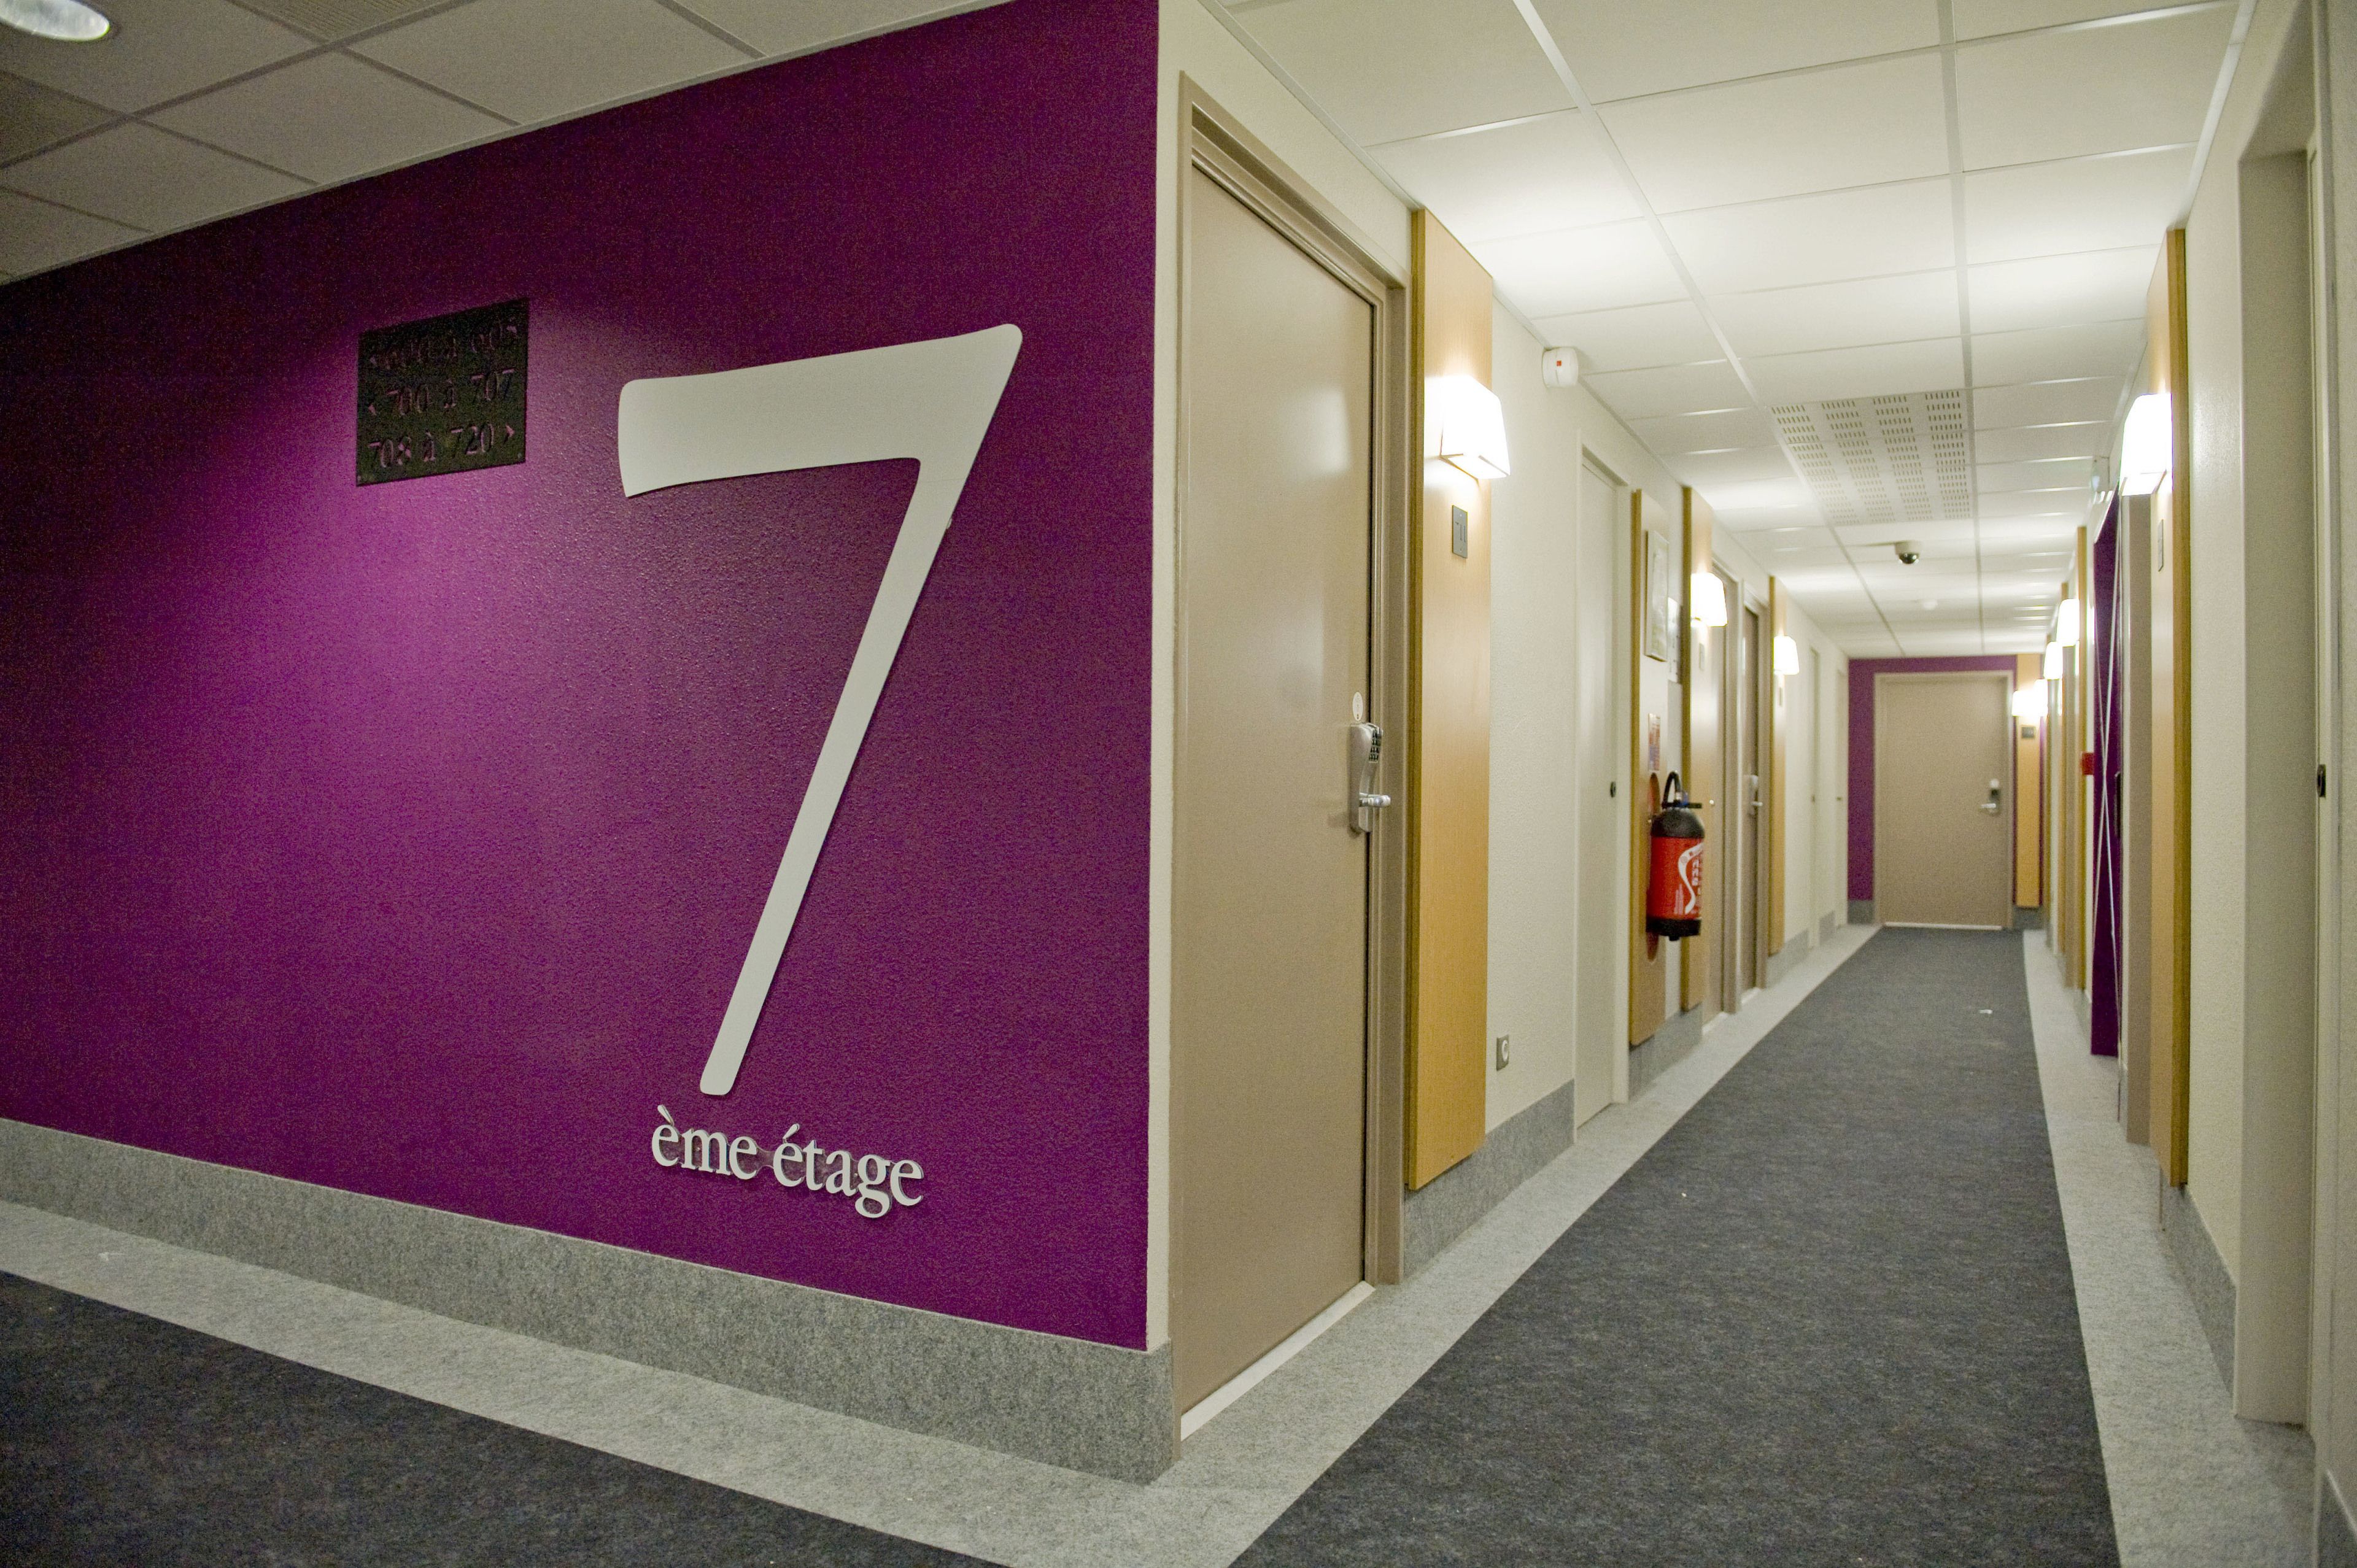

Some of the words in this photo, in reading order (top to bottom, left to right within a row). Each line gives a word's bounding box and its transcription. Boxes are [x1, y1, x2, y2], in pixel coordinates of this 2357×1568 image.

[470, 368, 514, 404] 707
[367, 434, 412, 470] 708
[450, 421, 494, 458] 720
[618, 324, 1023, 1095] 7
[651, 1104, 757, 1180] ème
[773, 1123, 924, 1218] étage
